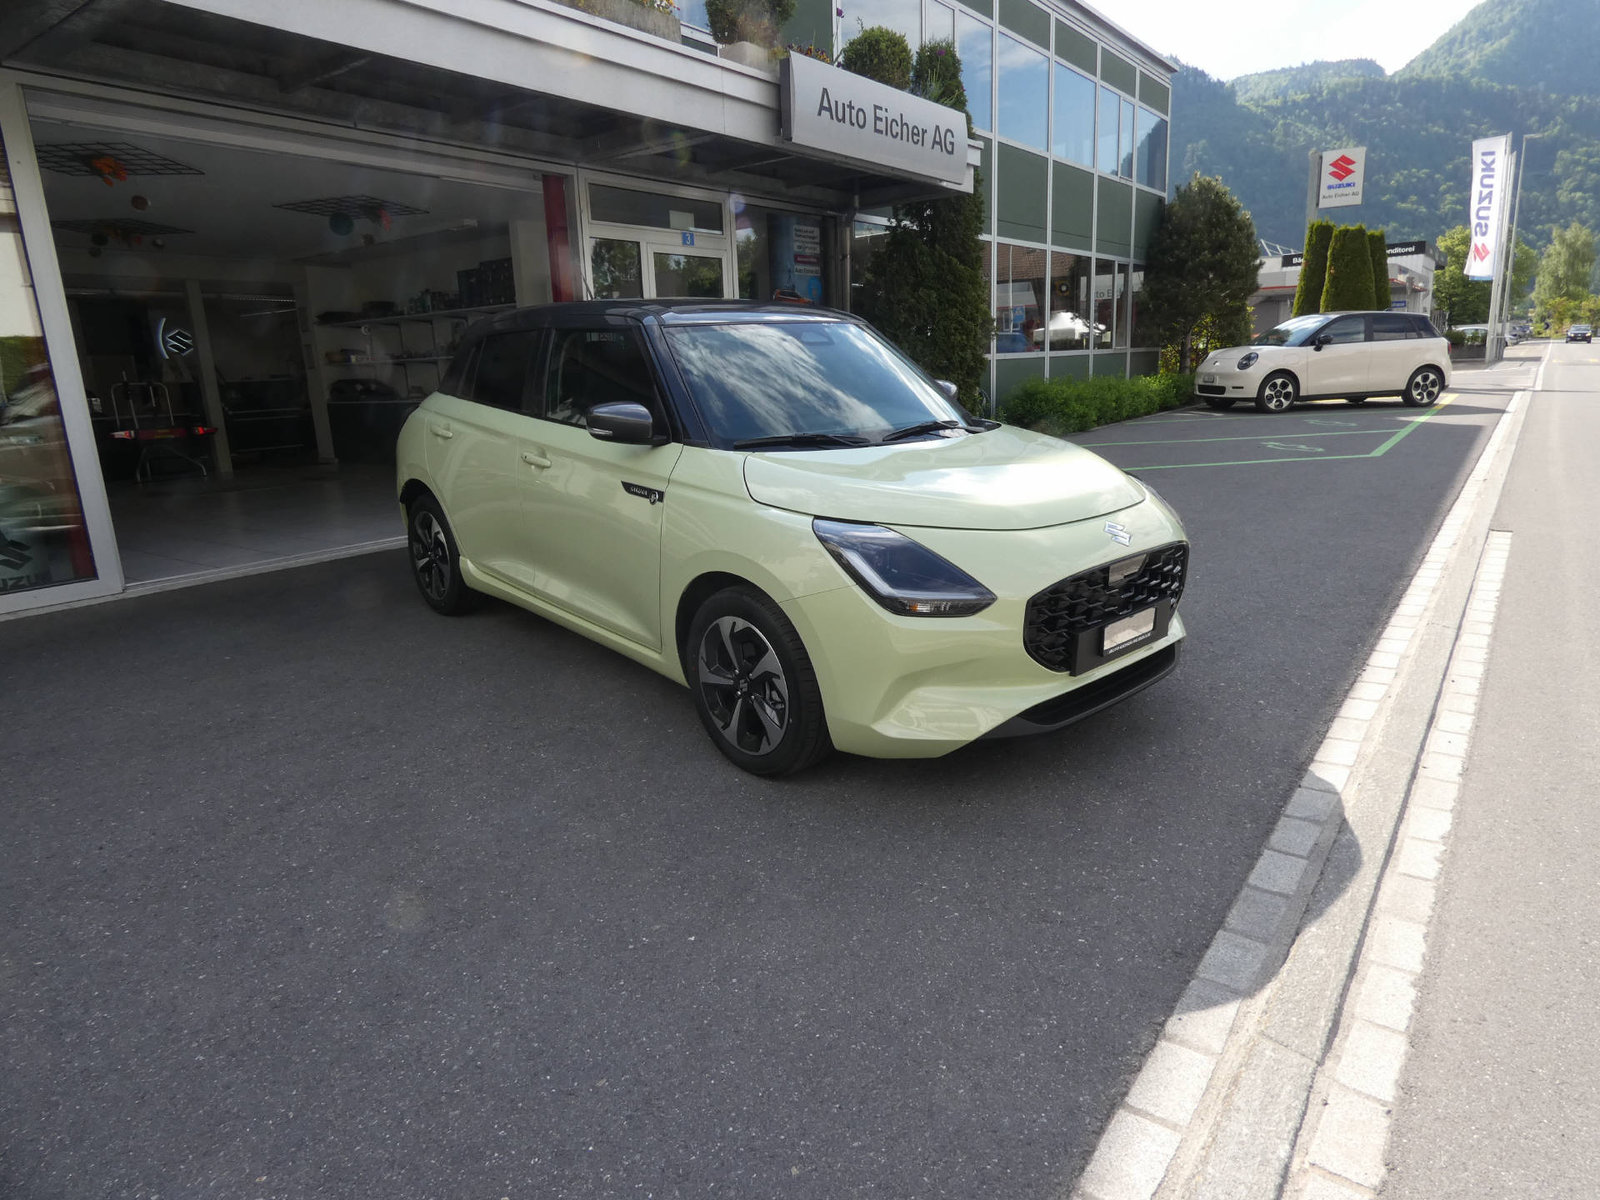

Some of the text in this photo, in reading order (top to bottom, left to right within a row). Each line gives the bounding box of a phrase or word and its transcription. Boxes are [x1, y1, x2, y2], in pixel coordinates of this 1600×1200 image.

[817, 87, 955, 155] Auto Eicher AG
